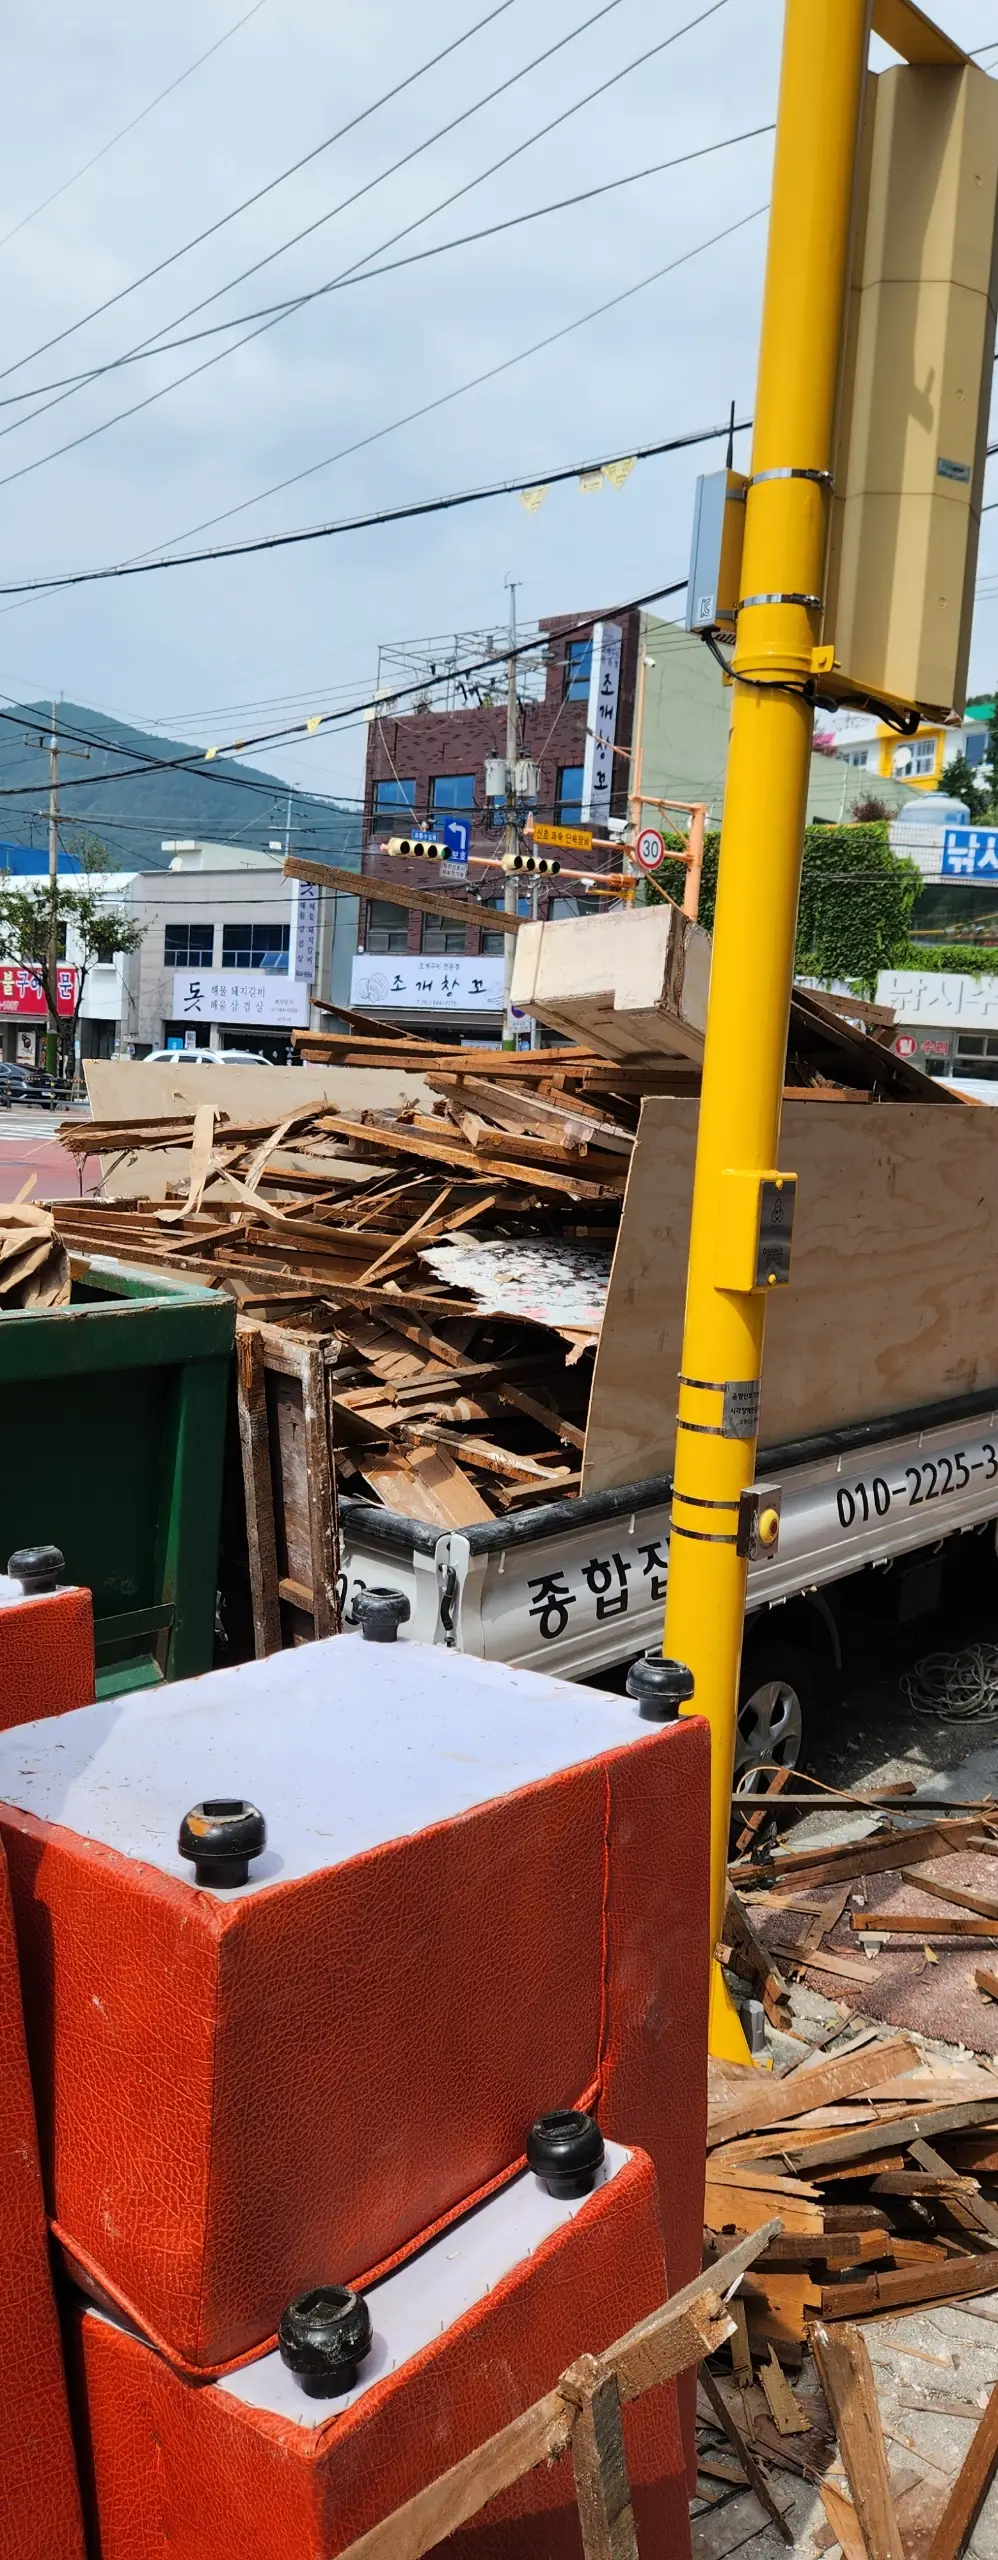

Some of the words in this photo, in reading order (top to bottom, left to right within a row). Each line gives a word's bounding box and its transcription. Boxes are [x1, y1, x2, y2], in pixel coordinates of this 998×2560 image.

[536, 827, 549, 840] 신호
[643, 840, 659, 857] 30
[211, 985, 227, 997] 해물
[231, 986, 265, 998] 돼지갈비
[210, 1000, 227, 1012] 해물
[836, 1444, 998, 1528] 010-2225-3
